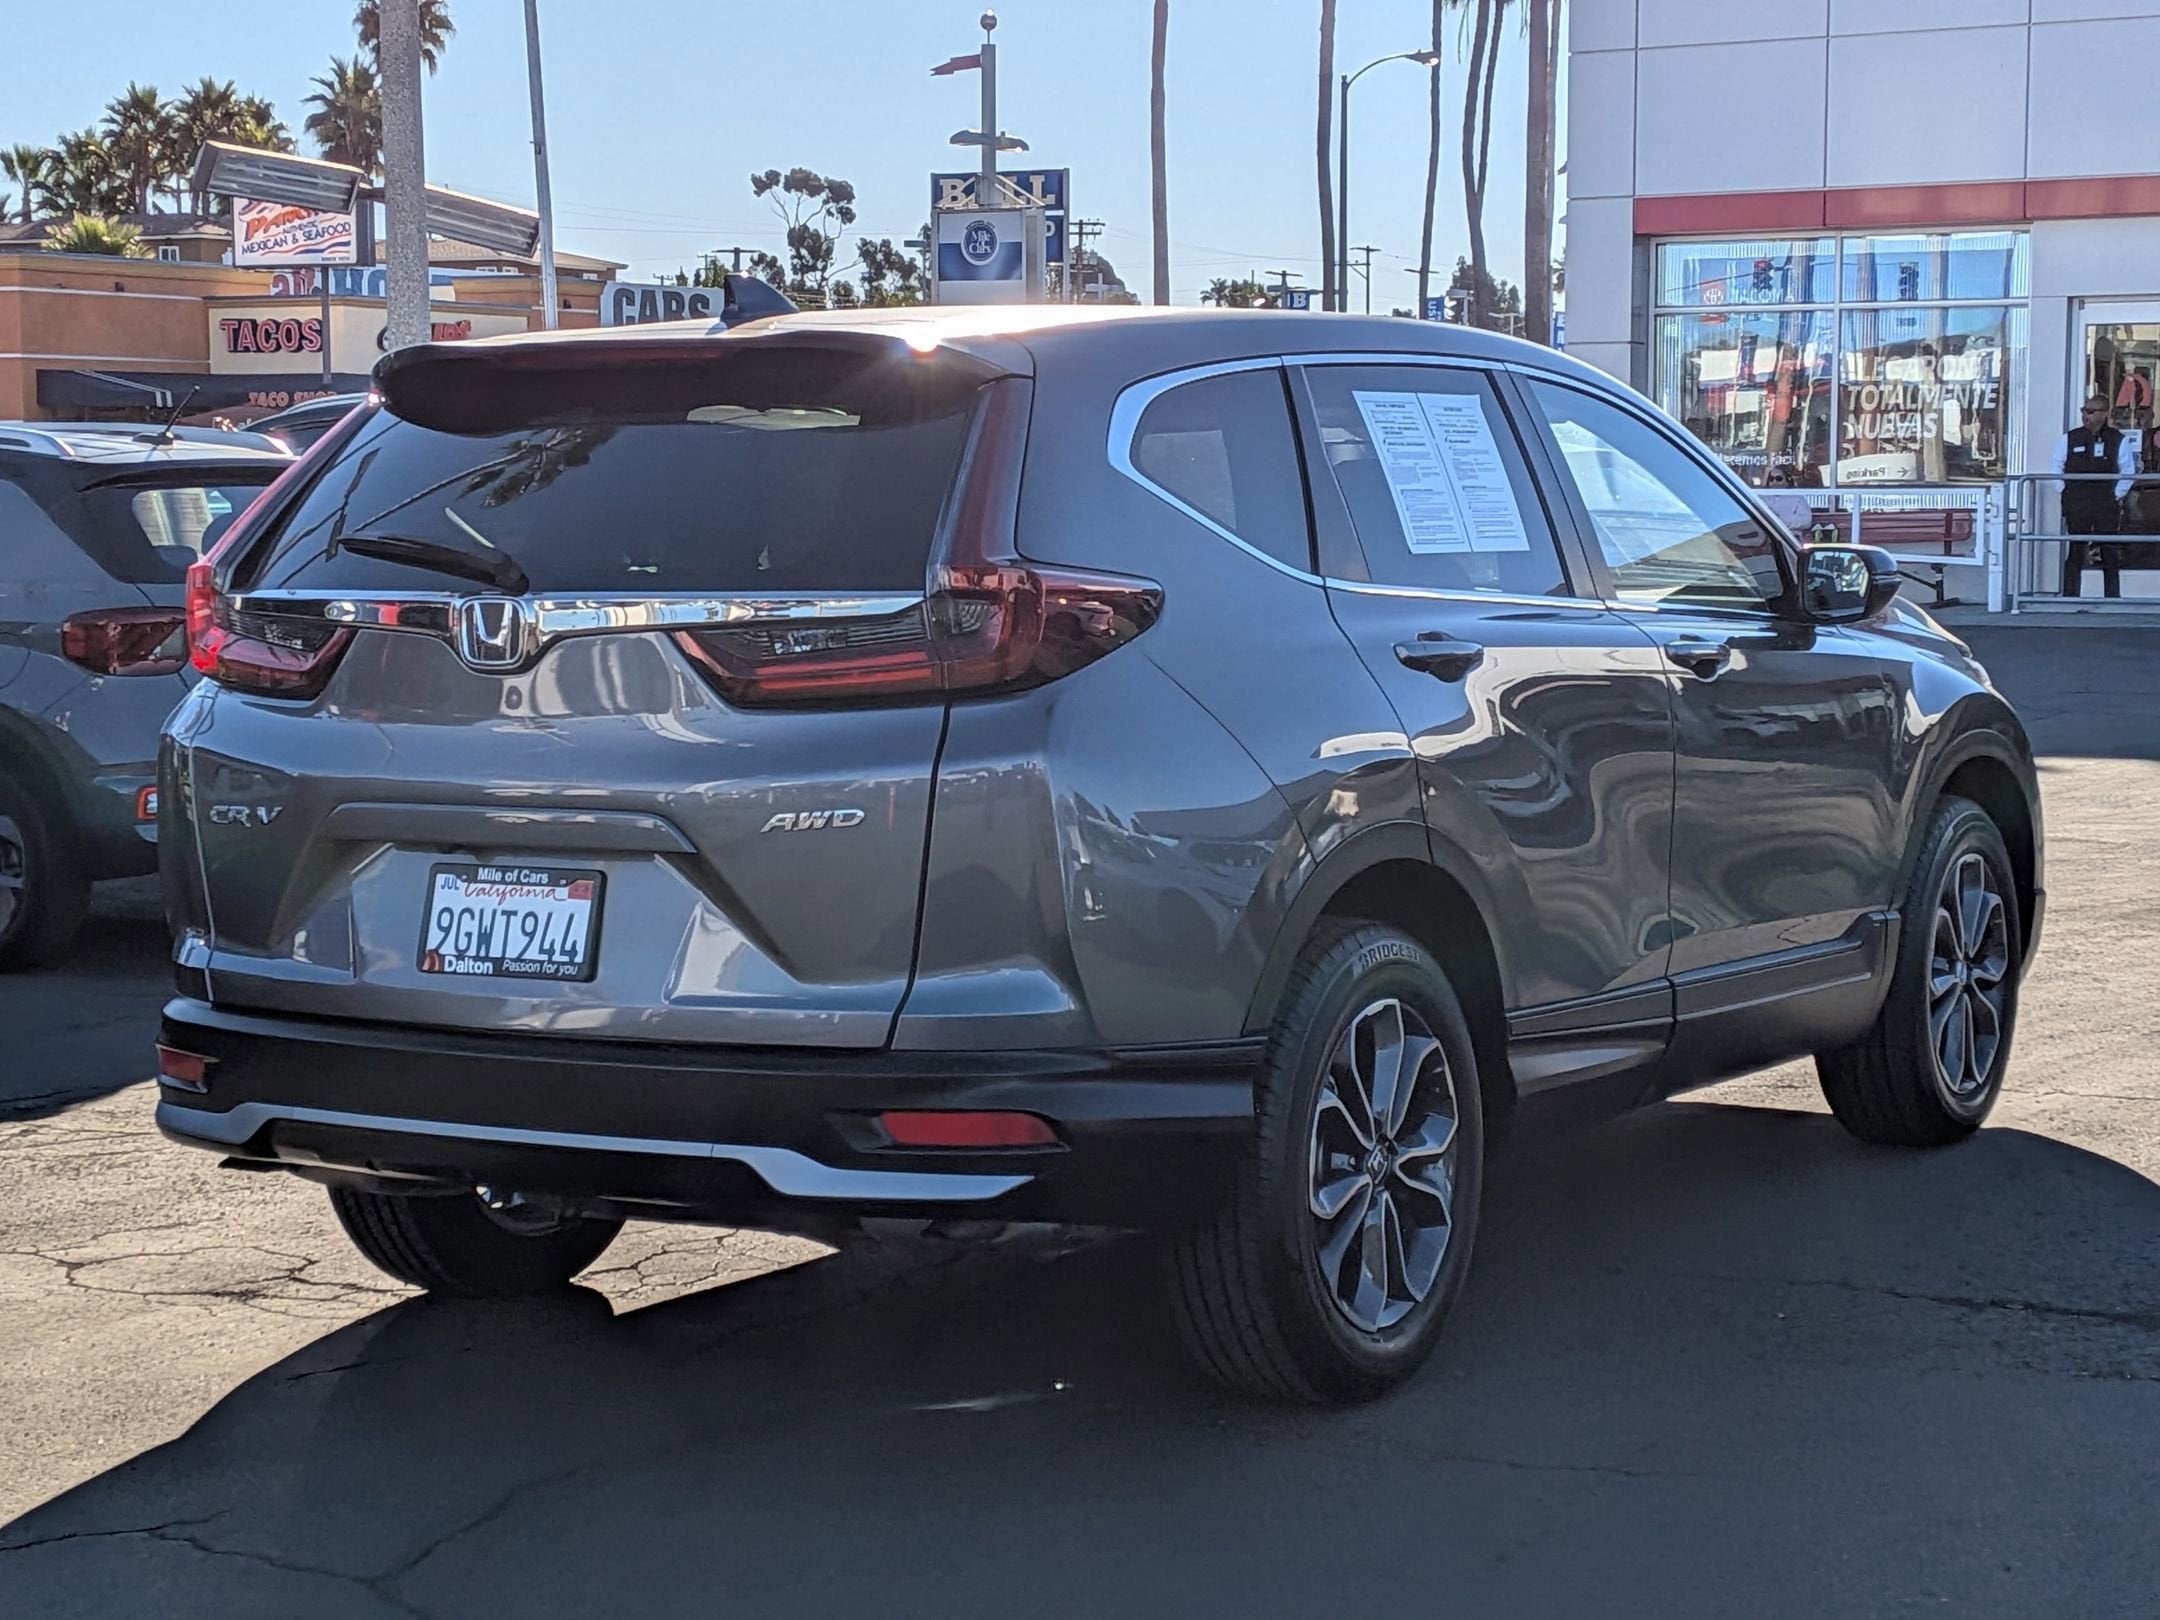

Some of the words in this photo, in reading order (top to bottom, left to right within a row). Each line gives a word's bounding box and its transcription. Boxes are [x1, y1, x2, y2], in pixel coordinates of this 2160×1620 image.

[940, 175, 1056, 208] BLL
[241, 235, 288, 255] MEXICAN
[292, 233, 299, 244] &
[302, 221, 351, 241] SEAFOOD
[613, 288, 710, 325] CARS
[219, 318, 324, 352] TACOS
[249, 391, 289, 407] TACO
[293, 391, 337, 404] SH
[1848, 382, 1999, 411] TOTALMENTE
[1844, 412, 1939, 439] NUEVAS
[760, 809, 865, 833] AWD
[440, 876, 460, 890] JUL
[477, 867, 502, 882] Mile
[505, 869, 518, 882] of
[519, 870, 549, 885] Cars
[464, 881, 567, 906] California
[434, 906, 579, 963] 9GWT944
[444, 955, 493, 975] Dalton
[502, 959, 541, 973] Passion
[542, 961, 559, 973] for
[559, 963, 578, 976] you
